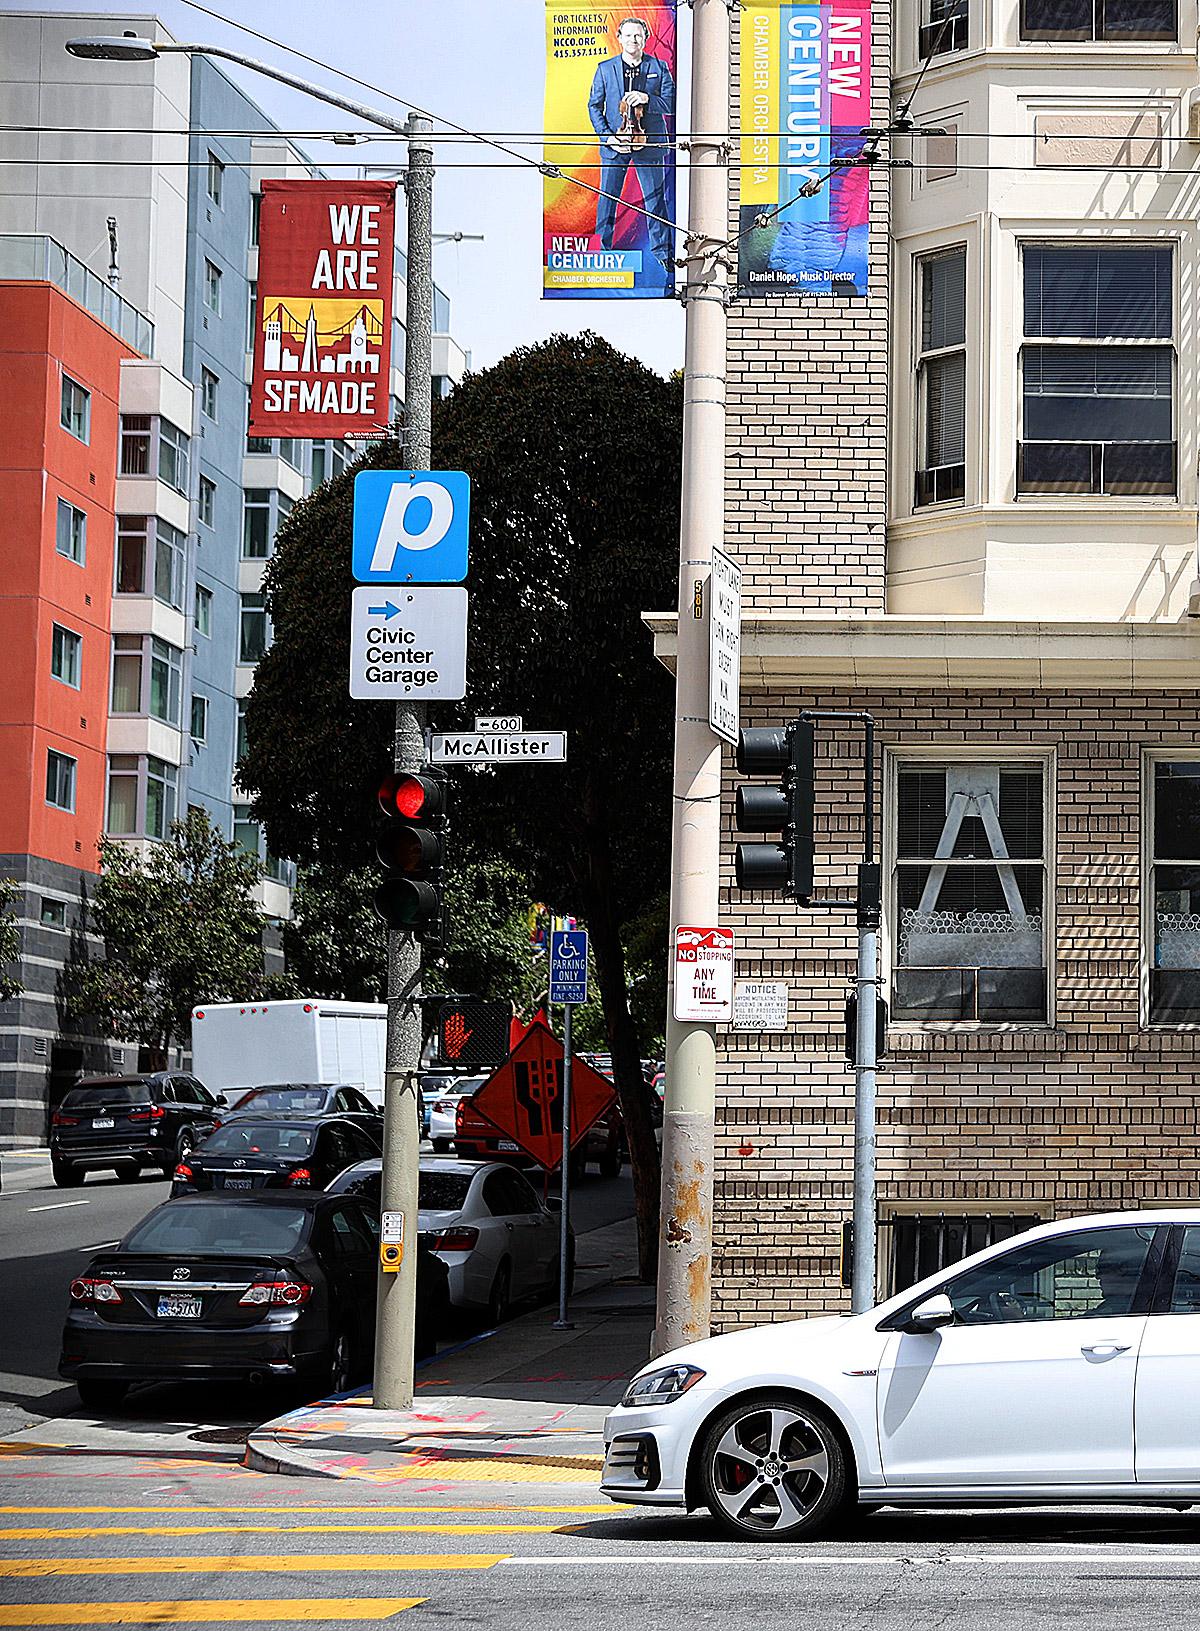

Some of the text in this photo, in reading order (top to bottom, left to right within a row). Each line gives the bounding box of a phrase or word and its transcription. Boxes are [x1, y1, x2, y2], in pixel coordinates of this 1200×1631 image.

[553, 14, 569, 24] FOR
[553, 25, 608, 36] INFORMATION
[553, 37, 596, 47] NCCO.ORG
[553, 47, 608, 58] 415.357.1111
[827, 16, 862, 99] NEW
[753, 15, 770, 185] CHAMBER ORCHESTRA
[787, 15, 823, 184] CENTURY
[328, 204, 382, 246] WE
[552, 236, 589, 252] NEW
[552, 253, 626, 269] CENTURY
[311, 249, 379, 291] ARE
[749, 270, 856, 283] Daniel Hope, Music Director
[552, 275, 626, 283] CHAMBER ORCHESTRA
[264, 378, 376, 415] SFMADE
[366, 627, 416, 644] Civic
[366, 646, 434, 664] Center
[365, 666, 439, 687] Garage
[491, 719, 517, 730] 600
[444, 738, 550, 756] McAllister
[678, 949, 732, 961] NO STOPPING
[552, 959, 586, 970] PARKING
[558, 970, 579, 981] ONLY
[693, 968, 716, 981] ANY
[692, 986, 717, 1000] TIME
[745, 985, 777, 994] NOTICE
